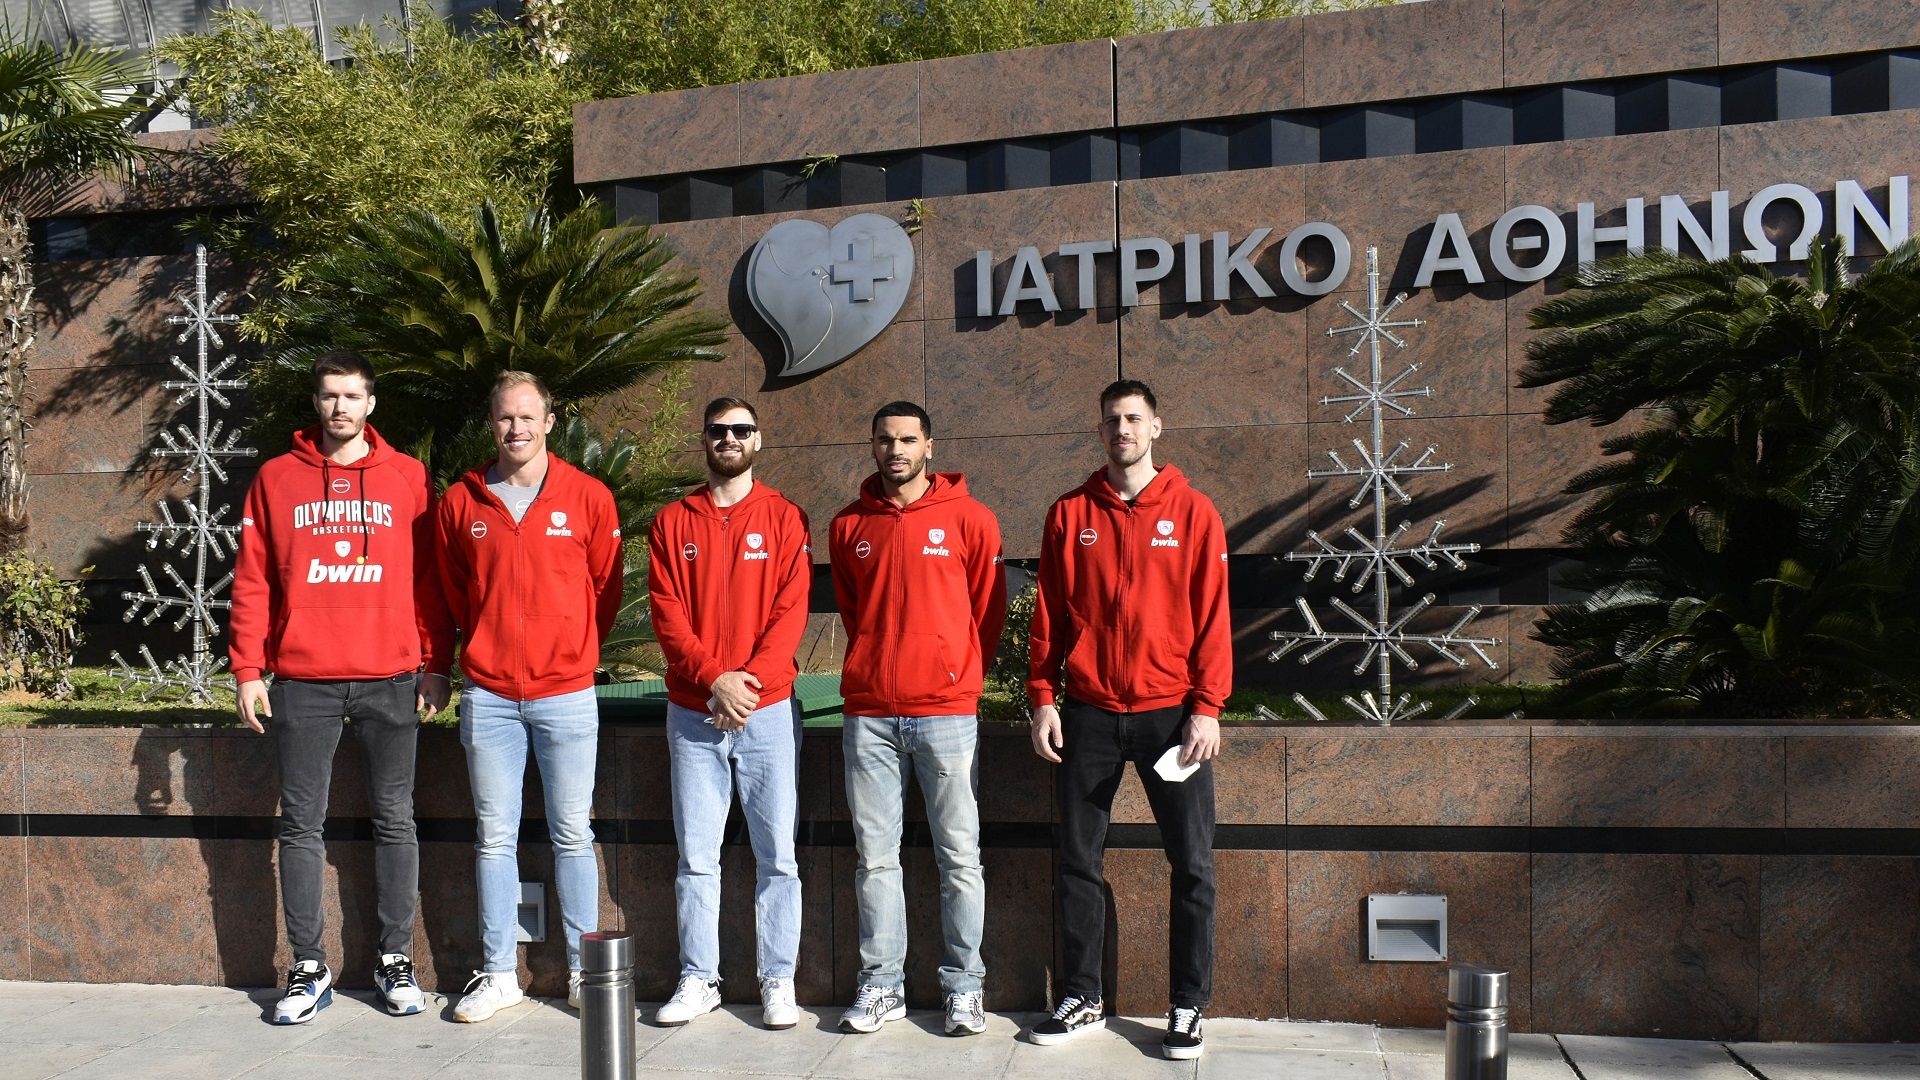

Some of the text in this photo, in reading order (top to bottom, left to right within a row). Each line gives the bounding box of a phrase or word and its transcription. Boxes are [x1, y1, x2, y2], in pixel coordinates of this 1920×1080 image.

[976, 175, 1909, 316] ΙΑΤΡΙΚΟ ΑΘΗΝΩΝ
[293, 500, 393, 529] OLYMPIACOS
[312, 525, 376, 536] BASKETBALL
[306, 556, 383, 584] bwin
